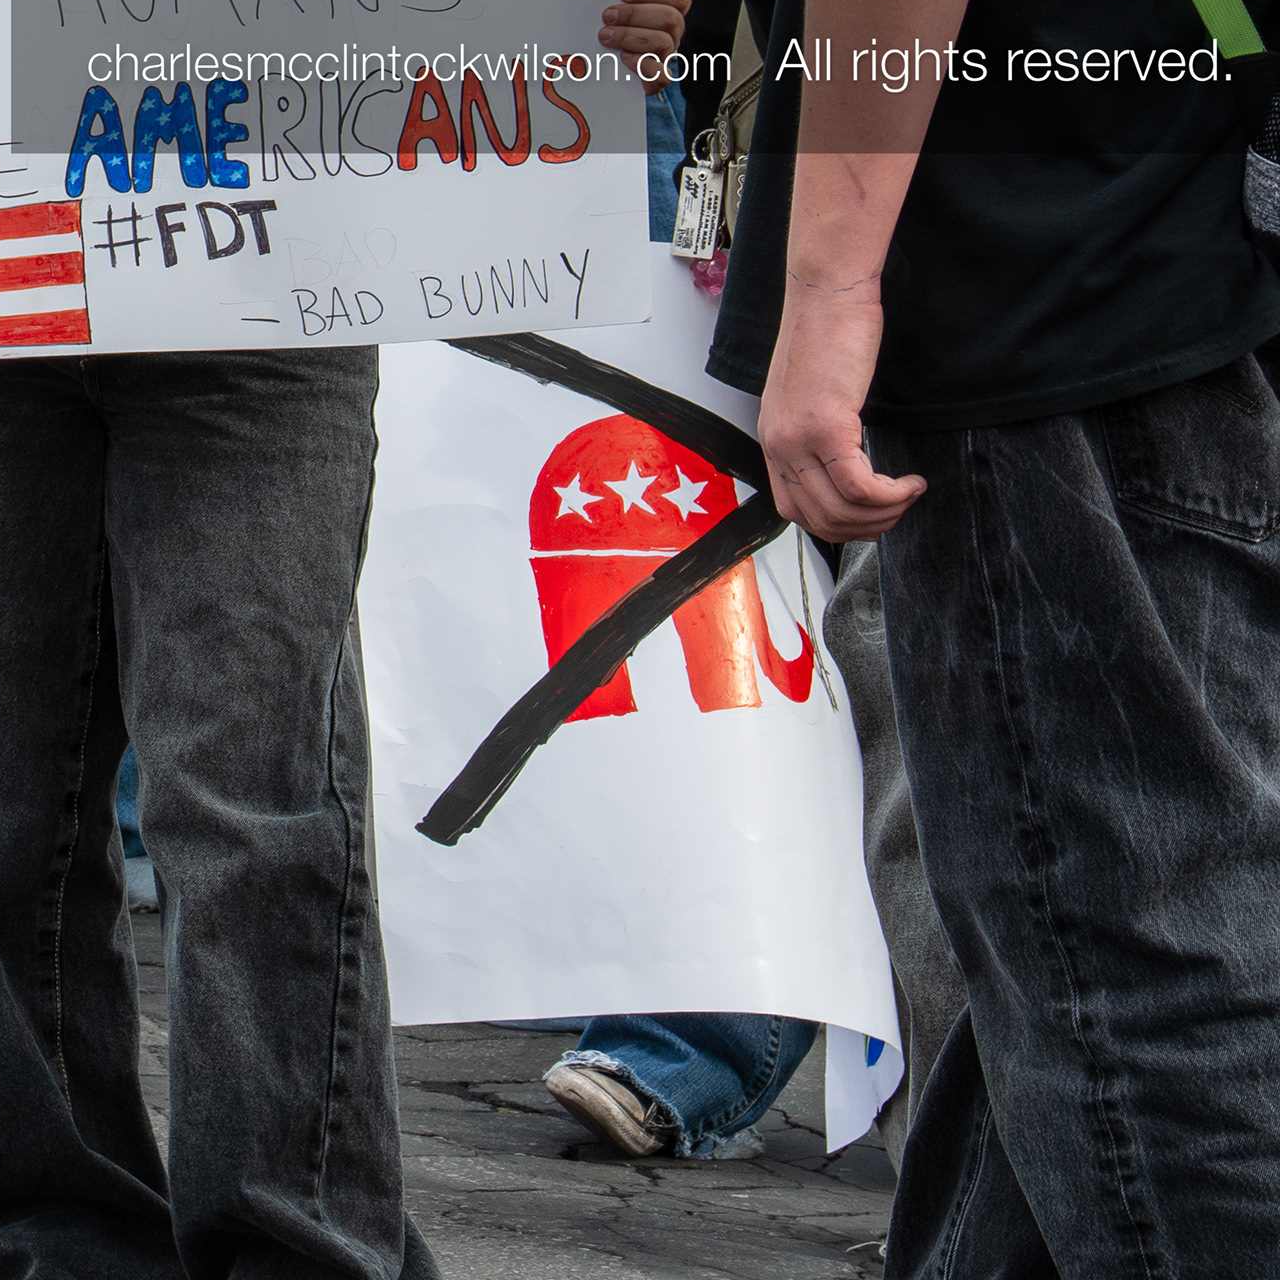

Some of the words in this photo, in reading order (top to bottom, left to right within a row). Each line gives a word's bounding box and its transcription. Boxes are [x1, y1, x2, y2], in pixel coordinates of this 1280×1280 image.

[65, 54, 592, 198] AMERICANS
[90, 199, 278, 268] #FDT
[420, 248, 590, 320] BUNNY
